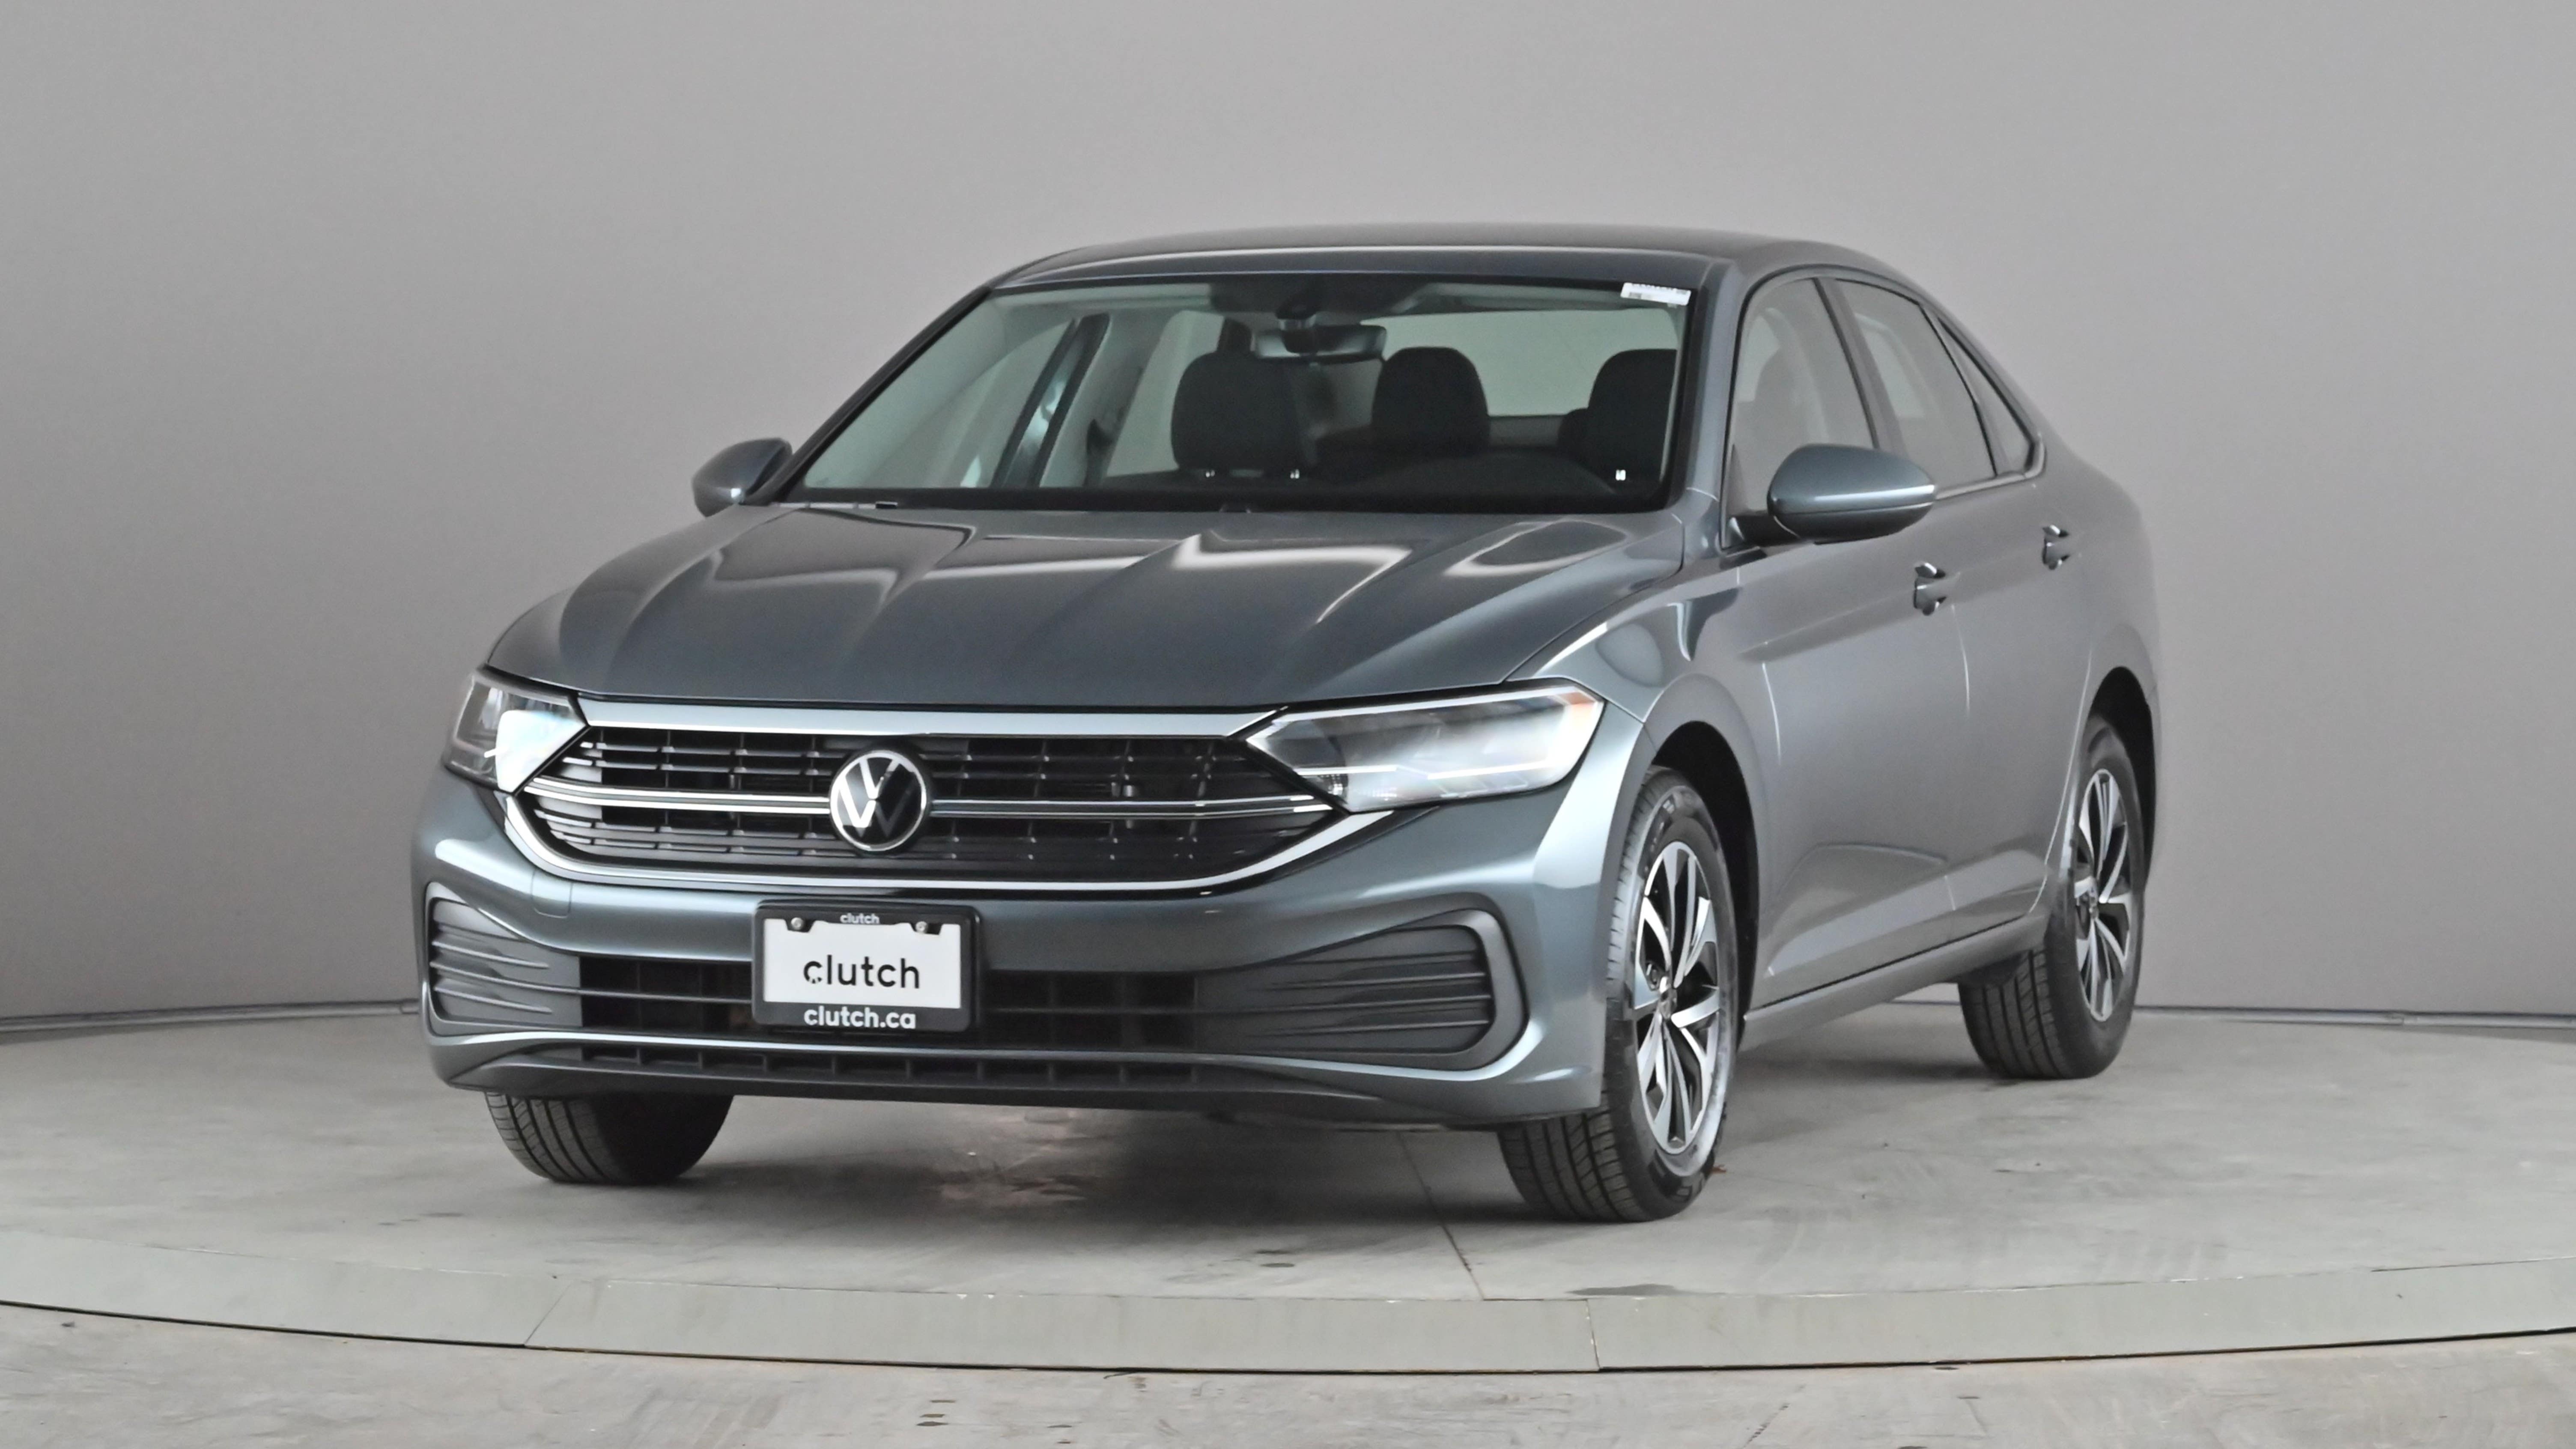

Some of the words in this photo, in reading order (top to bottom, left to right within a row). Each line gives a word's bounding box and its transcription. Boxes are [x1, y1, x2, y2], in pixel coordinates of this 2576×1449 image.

[840, 913, 880, 924] clutch
[804, 955, 919, 988] clutch
[804, 1005, 915, 1029] clutch.ca
